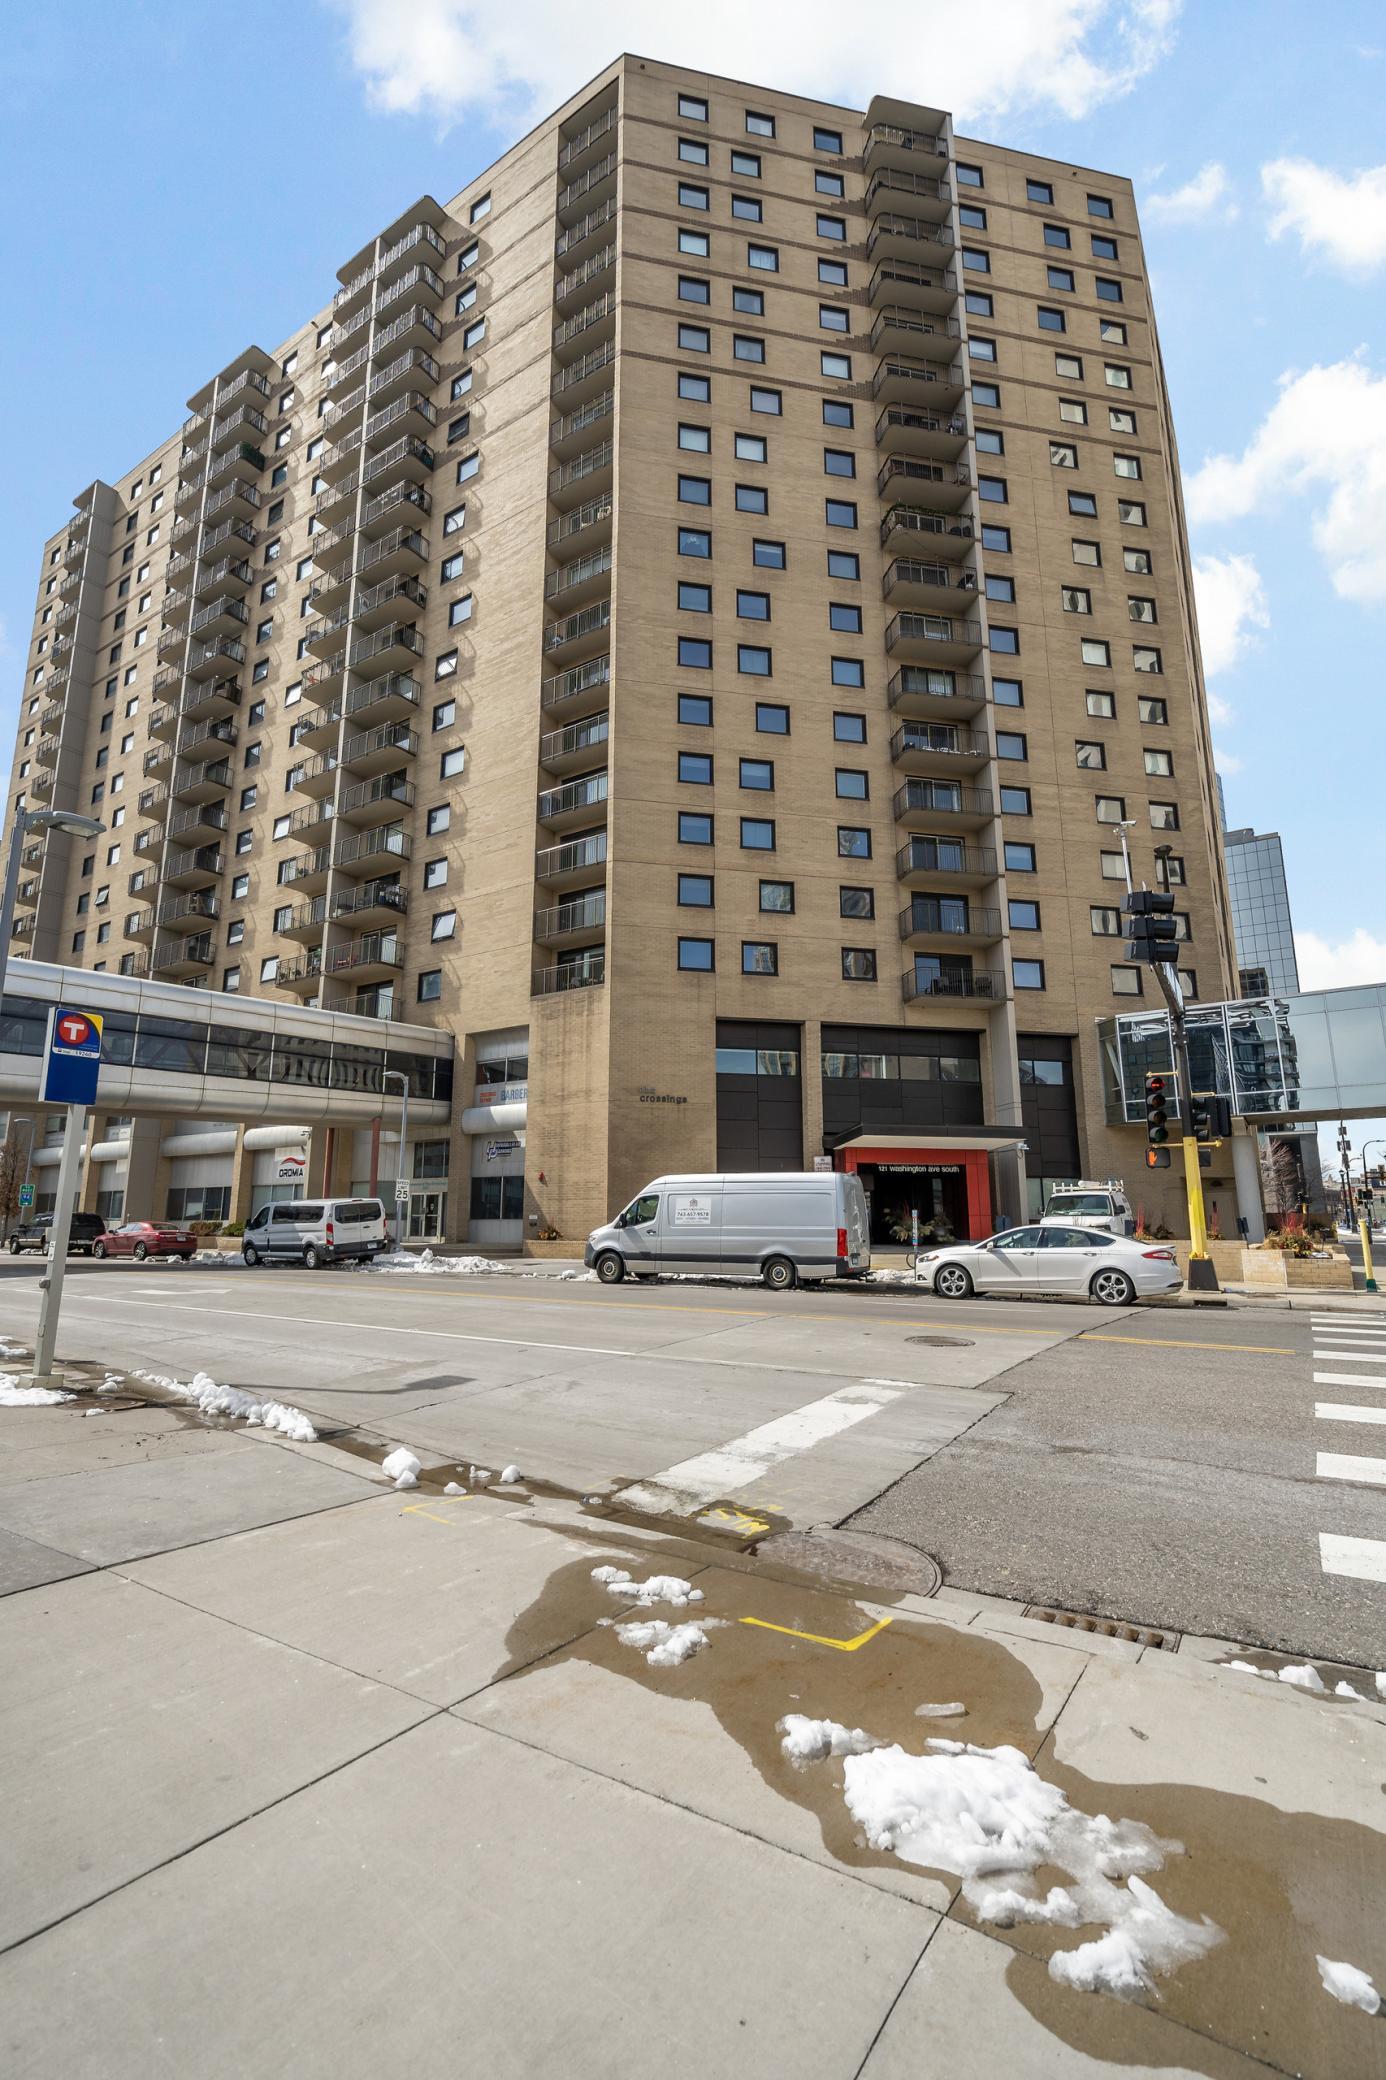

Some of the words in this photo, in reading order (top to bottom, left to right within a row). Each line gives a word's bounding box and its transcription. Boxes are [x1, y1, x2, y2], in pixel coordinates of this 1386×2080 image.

[63, 1021, 85, 1041] T
[640, 1095, 688, 1104] crossings
[279, 1168, 304, 1178] OROMIA
[889, 1165, 927, 1174] washington
[396, 1190, 408, 1199] 25
